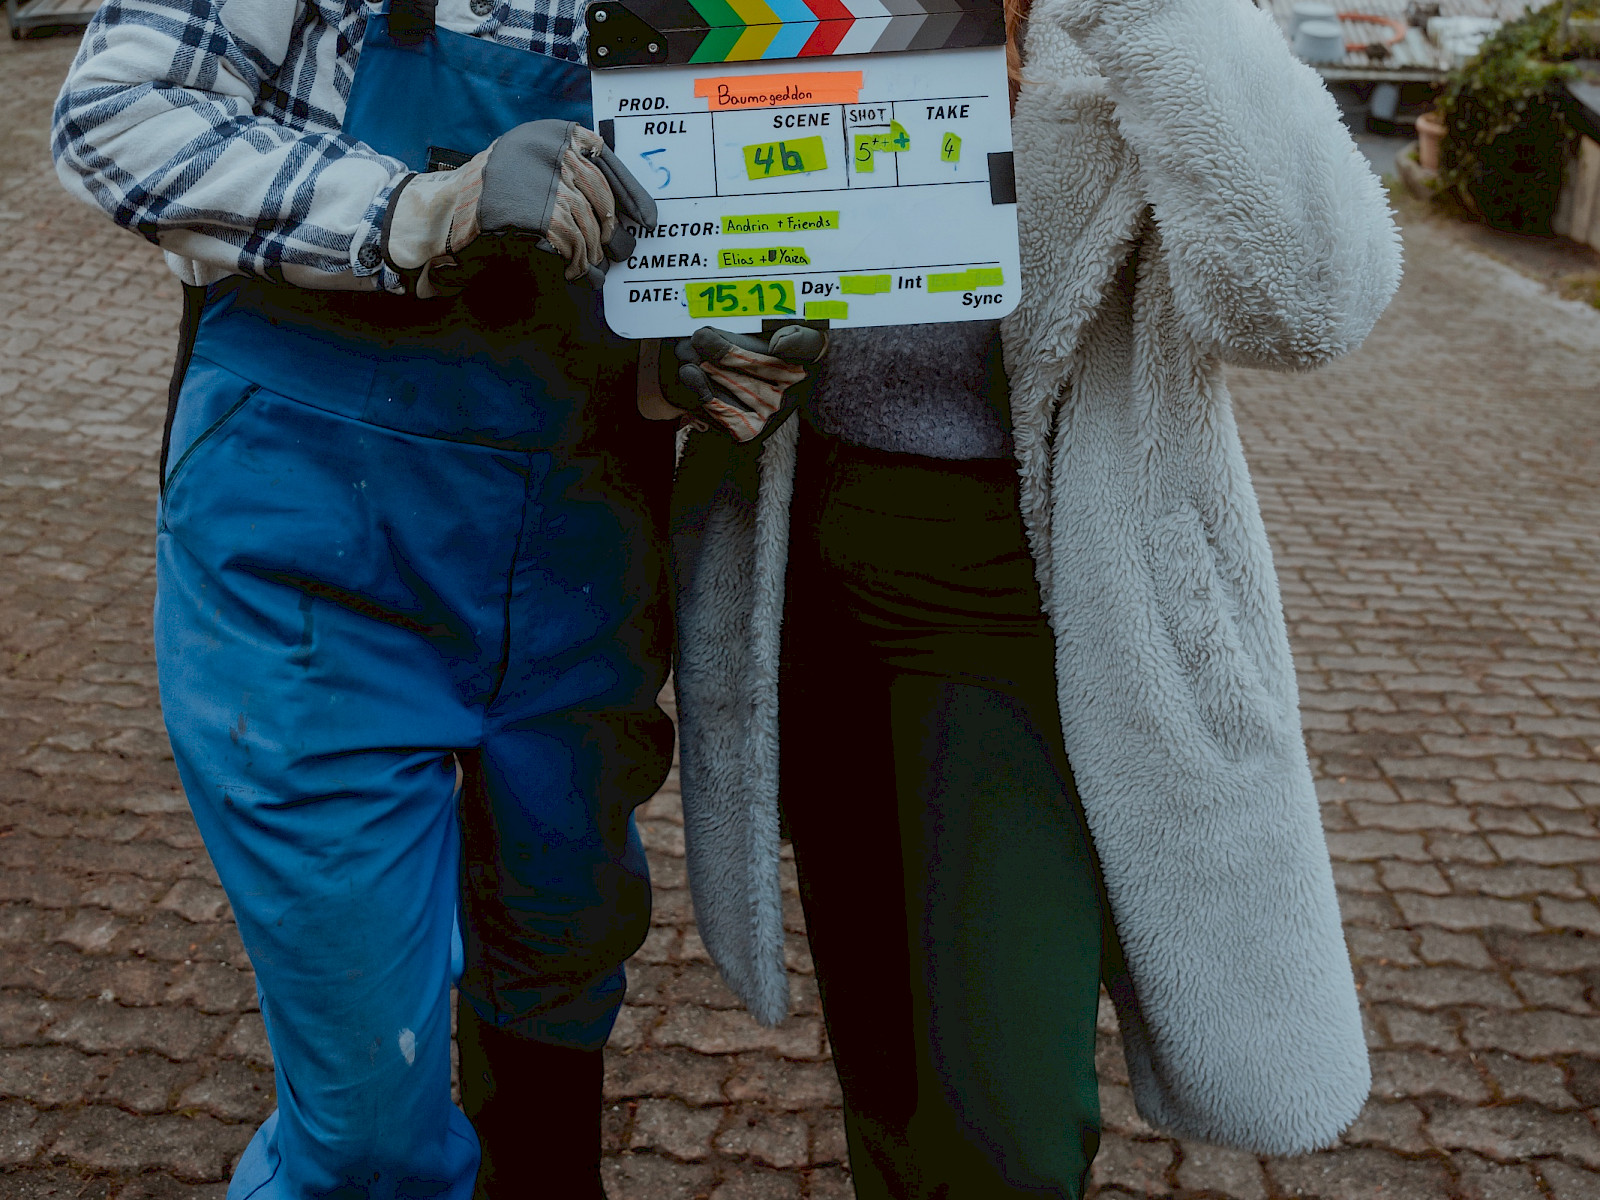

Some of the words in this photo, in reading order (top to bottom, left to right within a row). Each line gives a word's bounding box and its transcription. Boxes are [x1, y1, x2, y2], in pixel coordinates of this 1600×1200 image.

[718, 84, 812, 106] Baumageddon
[618, 97, 669, 112] PROD.
[926, 104, 970, 120] TAKE
[773, 112, 831, 129] SCENE
[849, 108, 887, 122] SHOT
[644, 120, 687, 135] ROLL
[754, 142, 804, 175] 4b
[639, 148, 671, 189] 5
[727, 218, 769, 232] Andrin
[787, 216, 831, 230] Friends
[627, 253, 708, 269] CAMERA:
[723, 252, 754, 266] Elias
[898, 275, 922, 290] Int
[629, 288, 679, 303] DATE:
[699, 283, 796, 316] 15.12
[962, 293, 1003, 309] Sync
